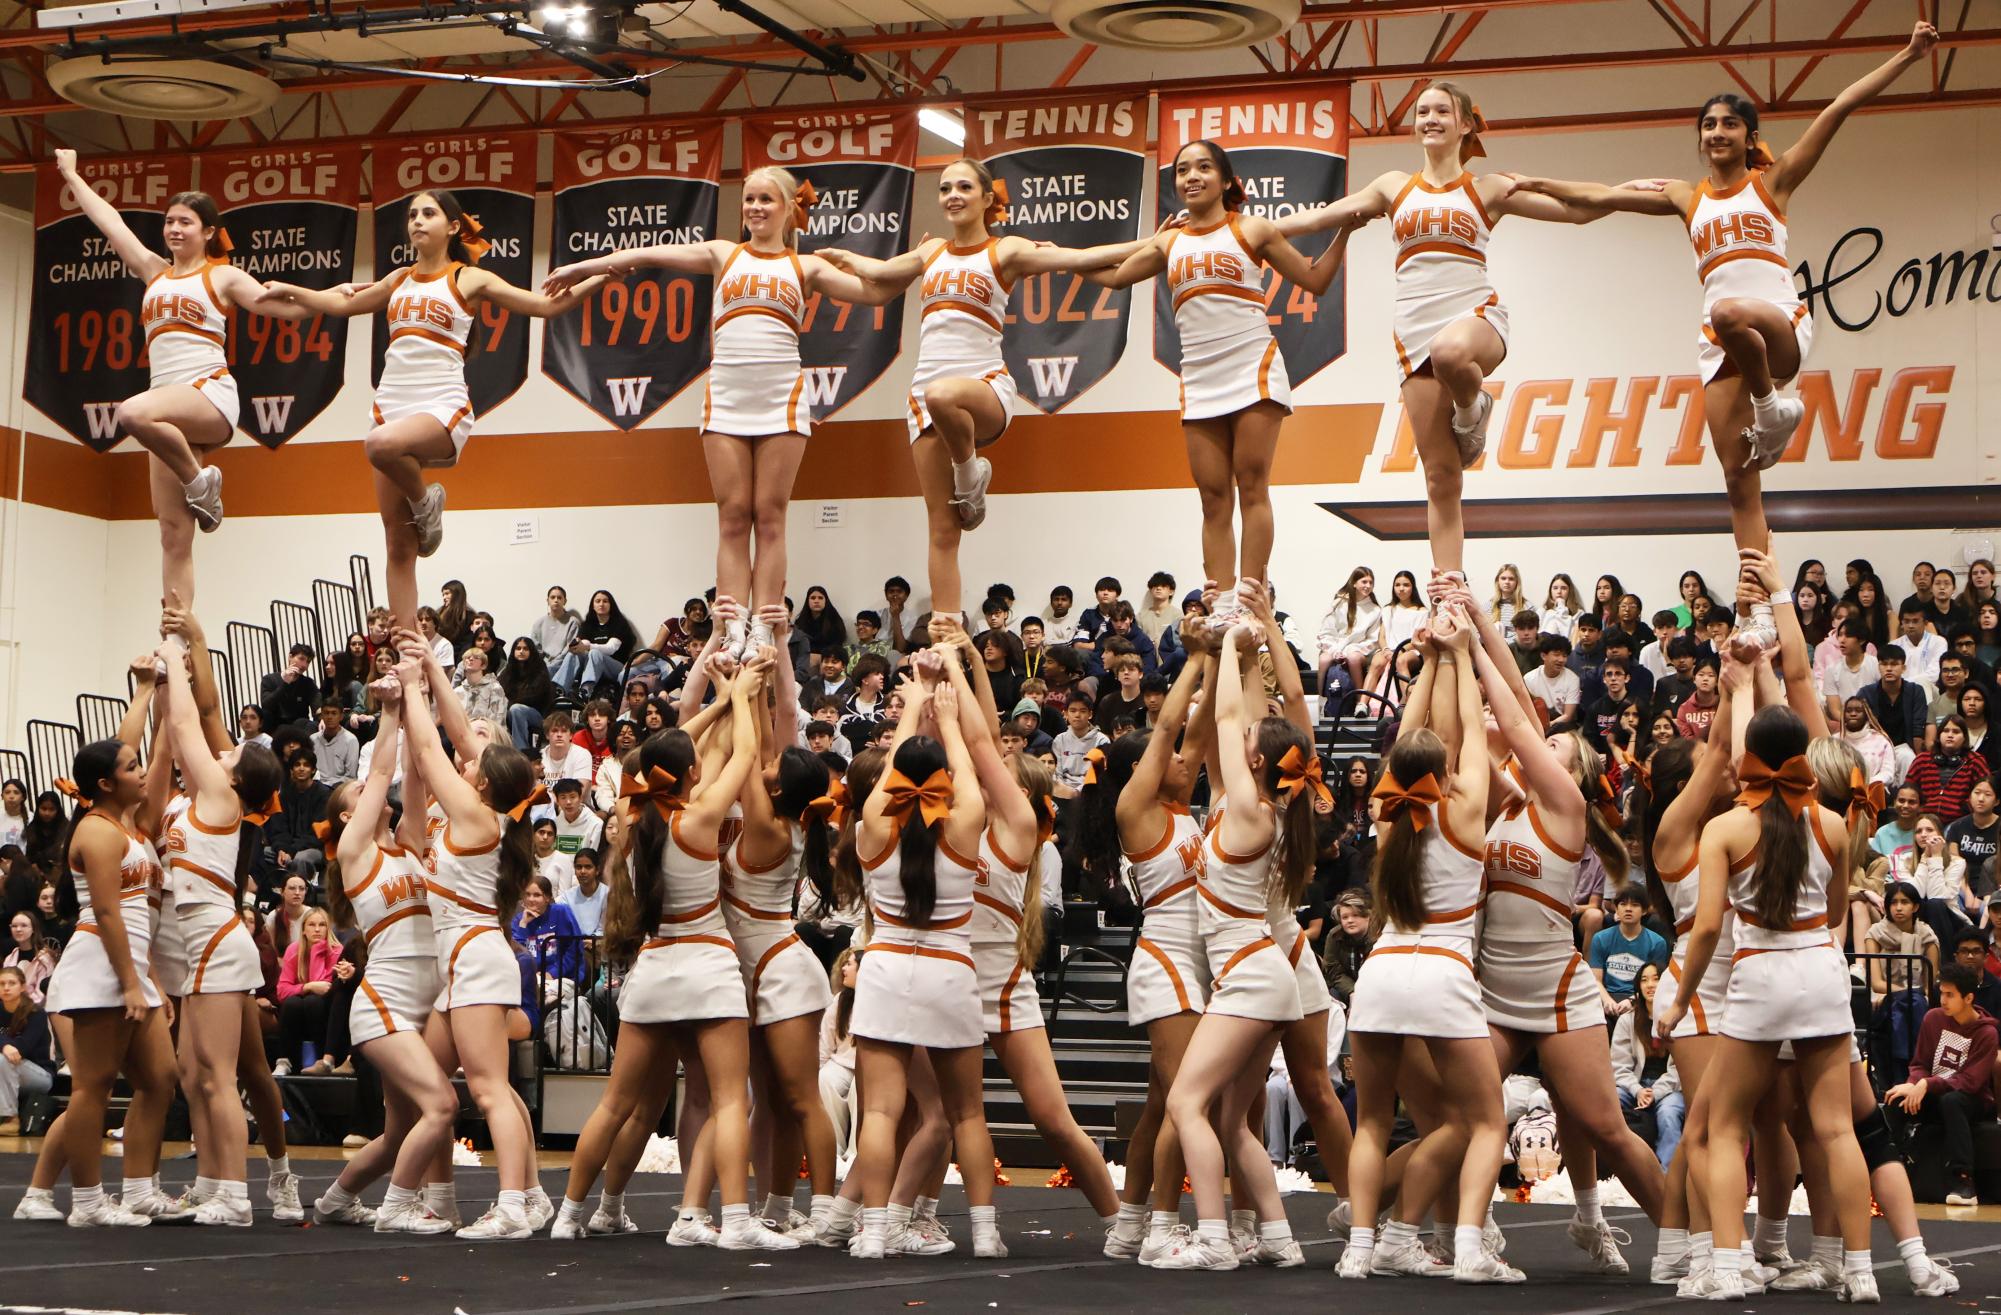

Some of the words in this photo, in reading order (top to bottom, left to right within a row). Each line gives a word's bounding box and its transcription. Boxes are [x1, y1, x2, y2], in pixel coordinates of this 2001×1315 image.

[798, 114, 866, 128] GIRLS
[979, 101, 1133, 145] TENNIS
[1173, 100, 1334, 146] TENNIS
[251, 152, 311, 168] GIRLS
[424, 139, 487, 154] GIRLS
[577, 140, 698, 176] GOLF
[767, 124, 893, 160] GOLF
[85, 162, 143, 177] GIRLS
[224, 165, 338, 202] GOLF
[397, 152, 513, 189] GOLF
[1021, 174, 1085, 198] STATE
[1244, 176, 1284, 199] ATE
[607, 204, 667, 227] STATE
[797, 211, 900, 235] MPIONS
[1001, 199, 1129, 227] HAMPIONS
[1393, 207, 1479, 247] WHS
[82, 238, 116, 257] STA
[252, 227, 306, 249] STATE
[569, 226, 704, 252] CHAMPIONS
[1692, 211, 1775, 265] WHS
[233, 249, 341, 273] HAMPIONS
[722, 272, 804, 317] WHS
[920, 268, 994, 307] WHS
[1261, 256, 1318, 325] 24
[580, 278, 695, 347] 1990
[227, 304, 333, 366] 1984
[802, 366, 848, 406] W
[1027, 356, 1078, 397] W
[606, 376, 651, 416] W
[252, 395, 295, 434] W
[1485, 840, 1542, 879] HS
[1960, 834, 1997, 856] BEATLES
[378, 874, 429, 909] WH
